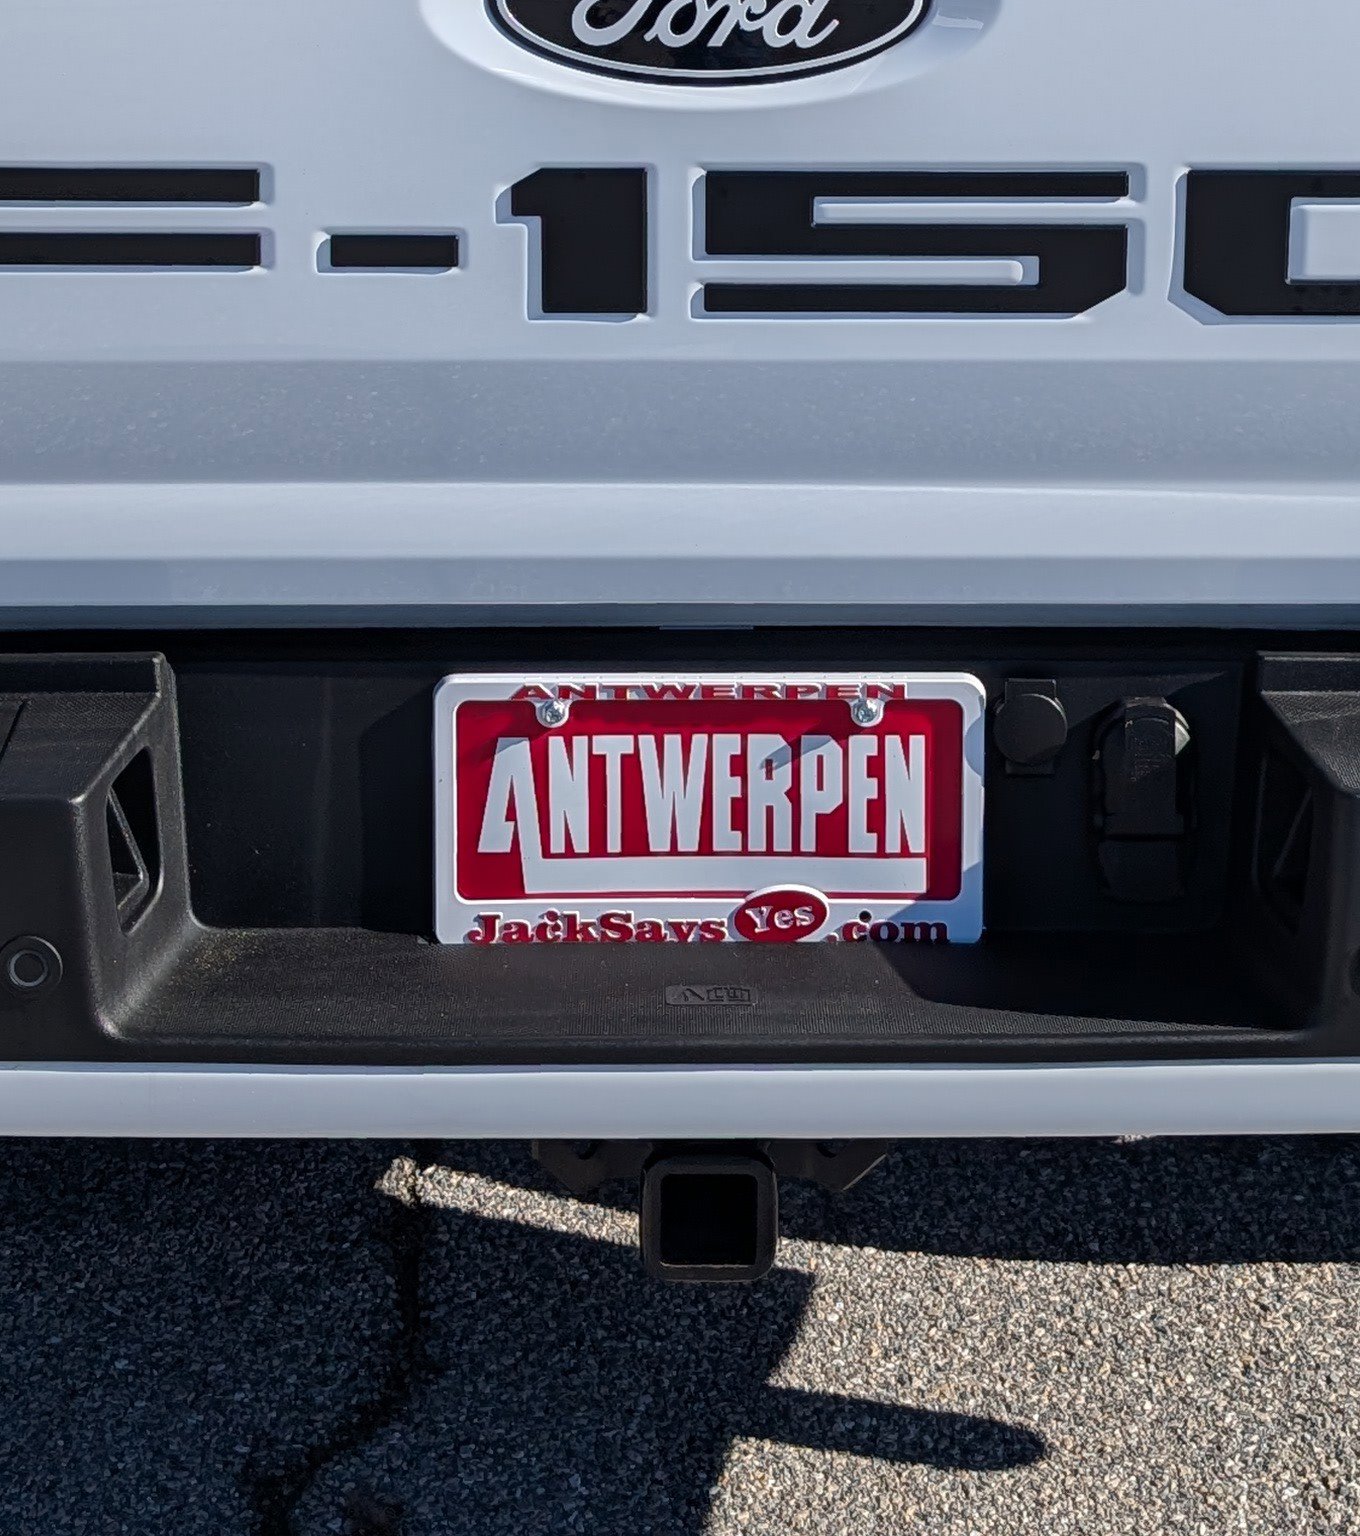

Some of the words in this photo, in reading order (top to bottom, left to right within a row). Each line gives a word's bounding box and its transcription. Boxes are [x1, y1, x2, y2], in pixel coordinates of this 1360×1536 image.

[510, 683, 908, 700] ANTWERPEN
[477, 733, 928, 894] ANTWERPEN
[466, 910, 730, 943] JackSays
[745, 904, 816, 933] Yes
[824, 920, 950, 943] .com
